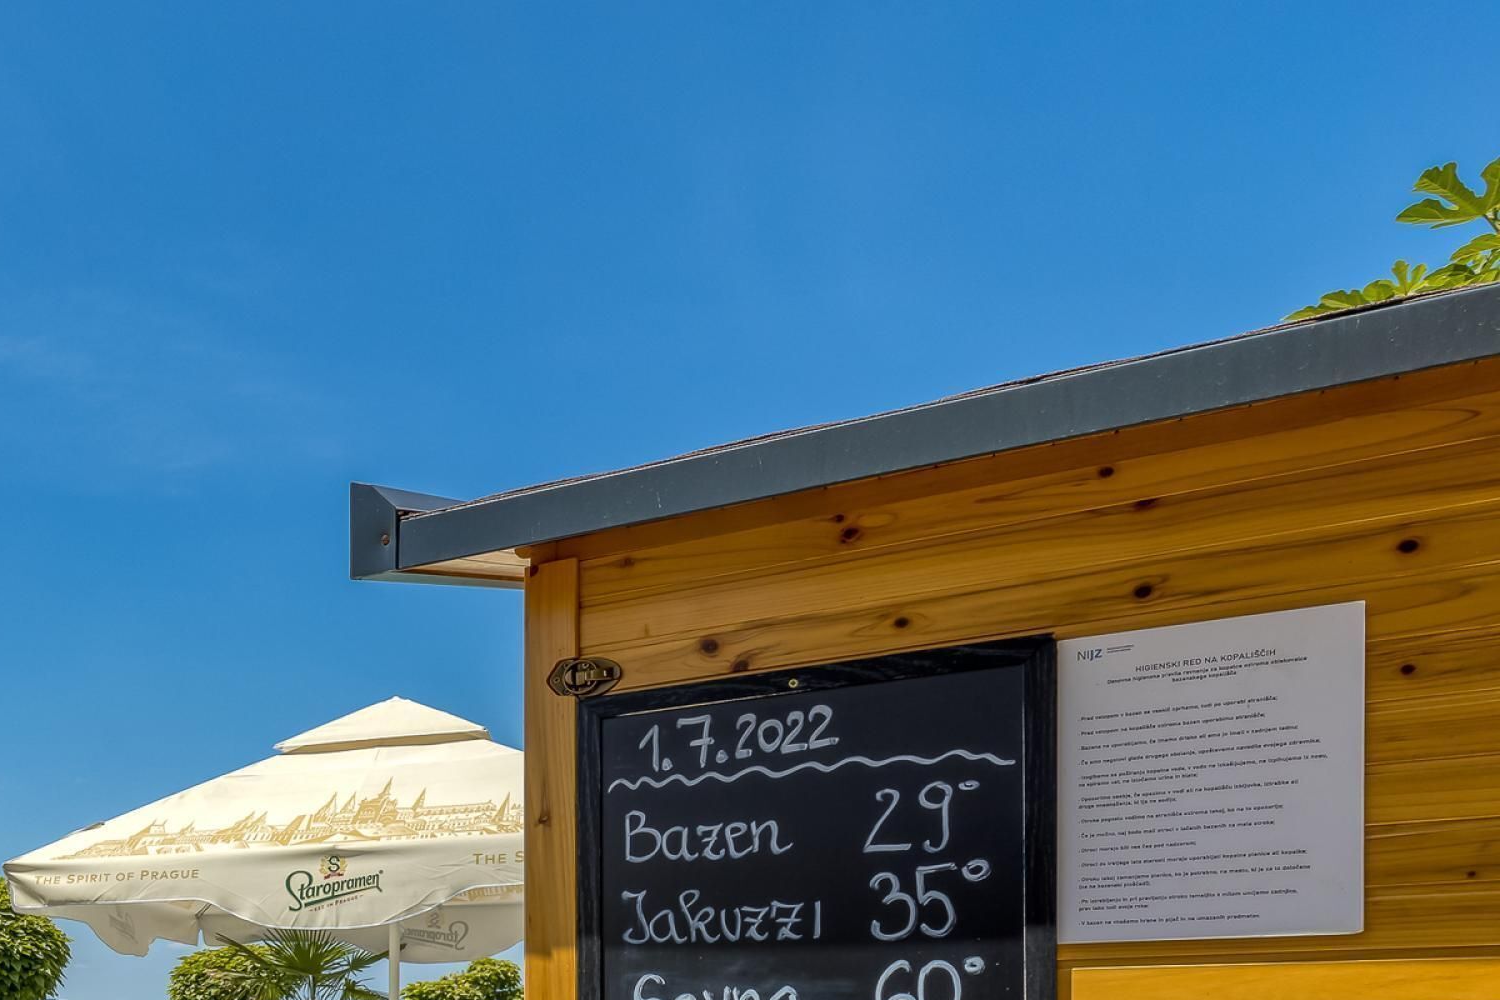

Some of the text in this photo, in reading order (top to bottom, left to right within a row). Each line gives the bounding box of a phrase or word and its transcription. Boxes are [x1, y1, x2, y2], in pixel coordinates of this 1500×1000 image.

[1077, 648, 1102, 662] NIJZ
[1135, 647, 1275, 672] HIGIENSKI RED NA KOPALIŠČIH
[625, 810, 793, 862] Bazen
[472, 853, 508, 865] THE
[34, 869, 200, 885] THE SPIRIT OF PRAGUE
[285, 870, 383, 911] Staropramen
